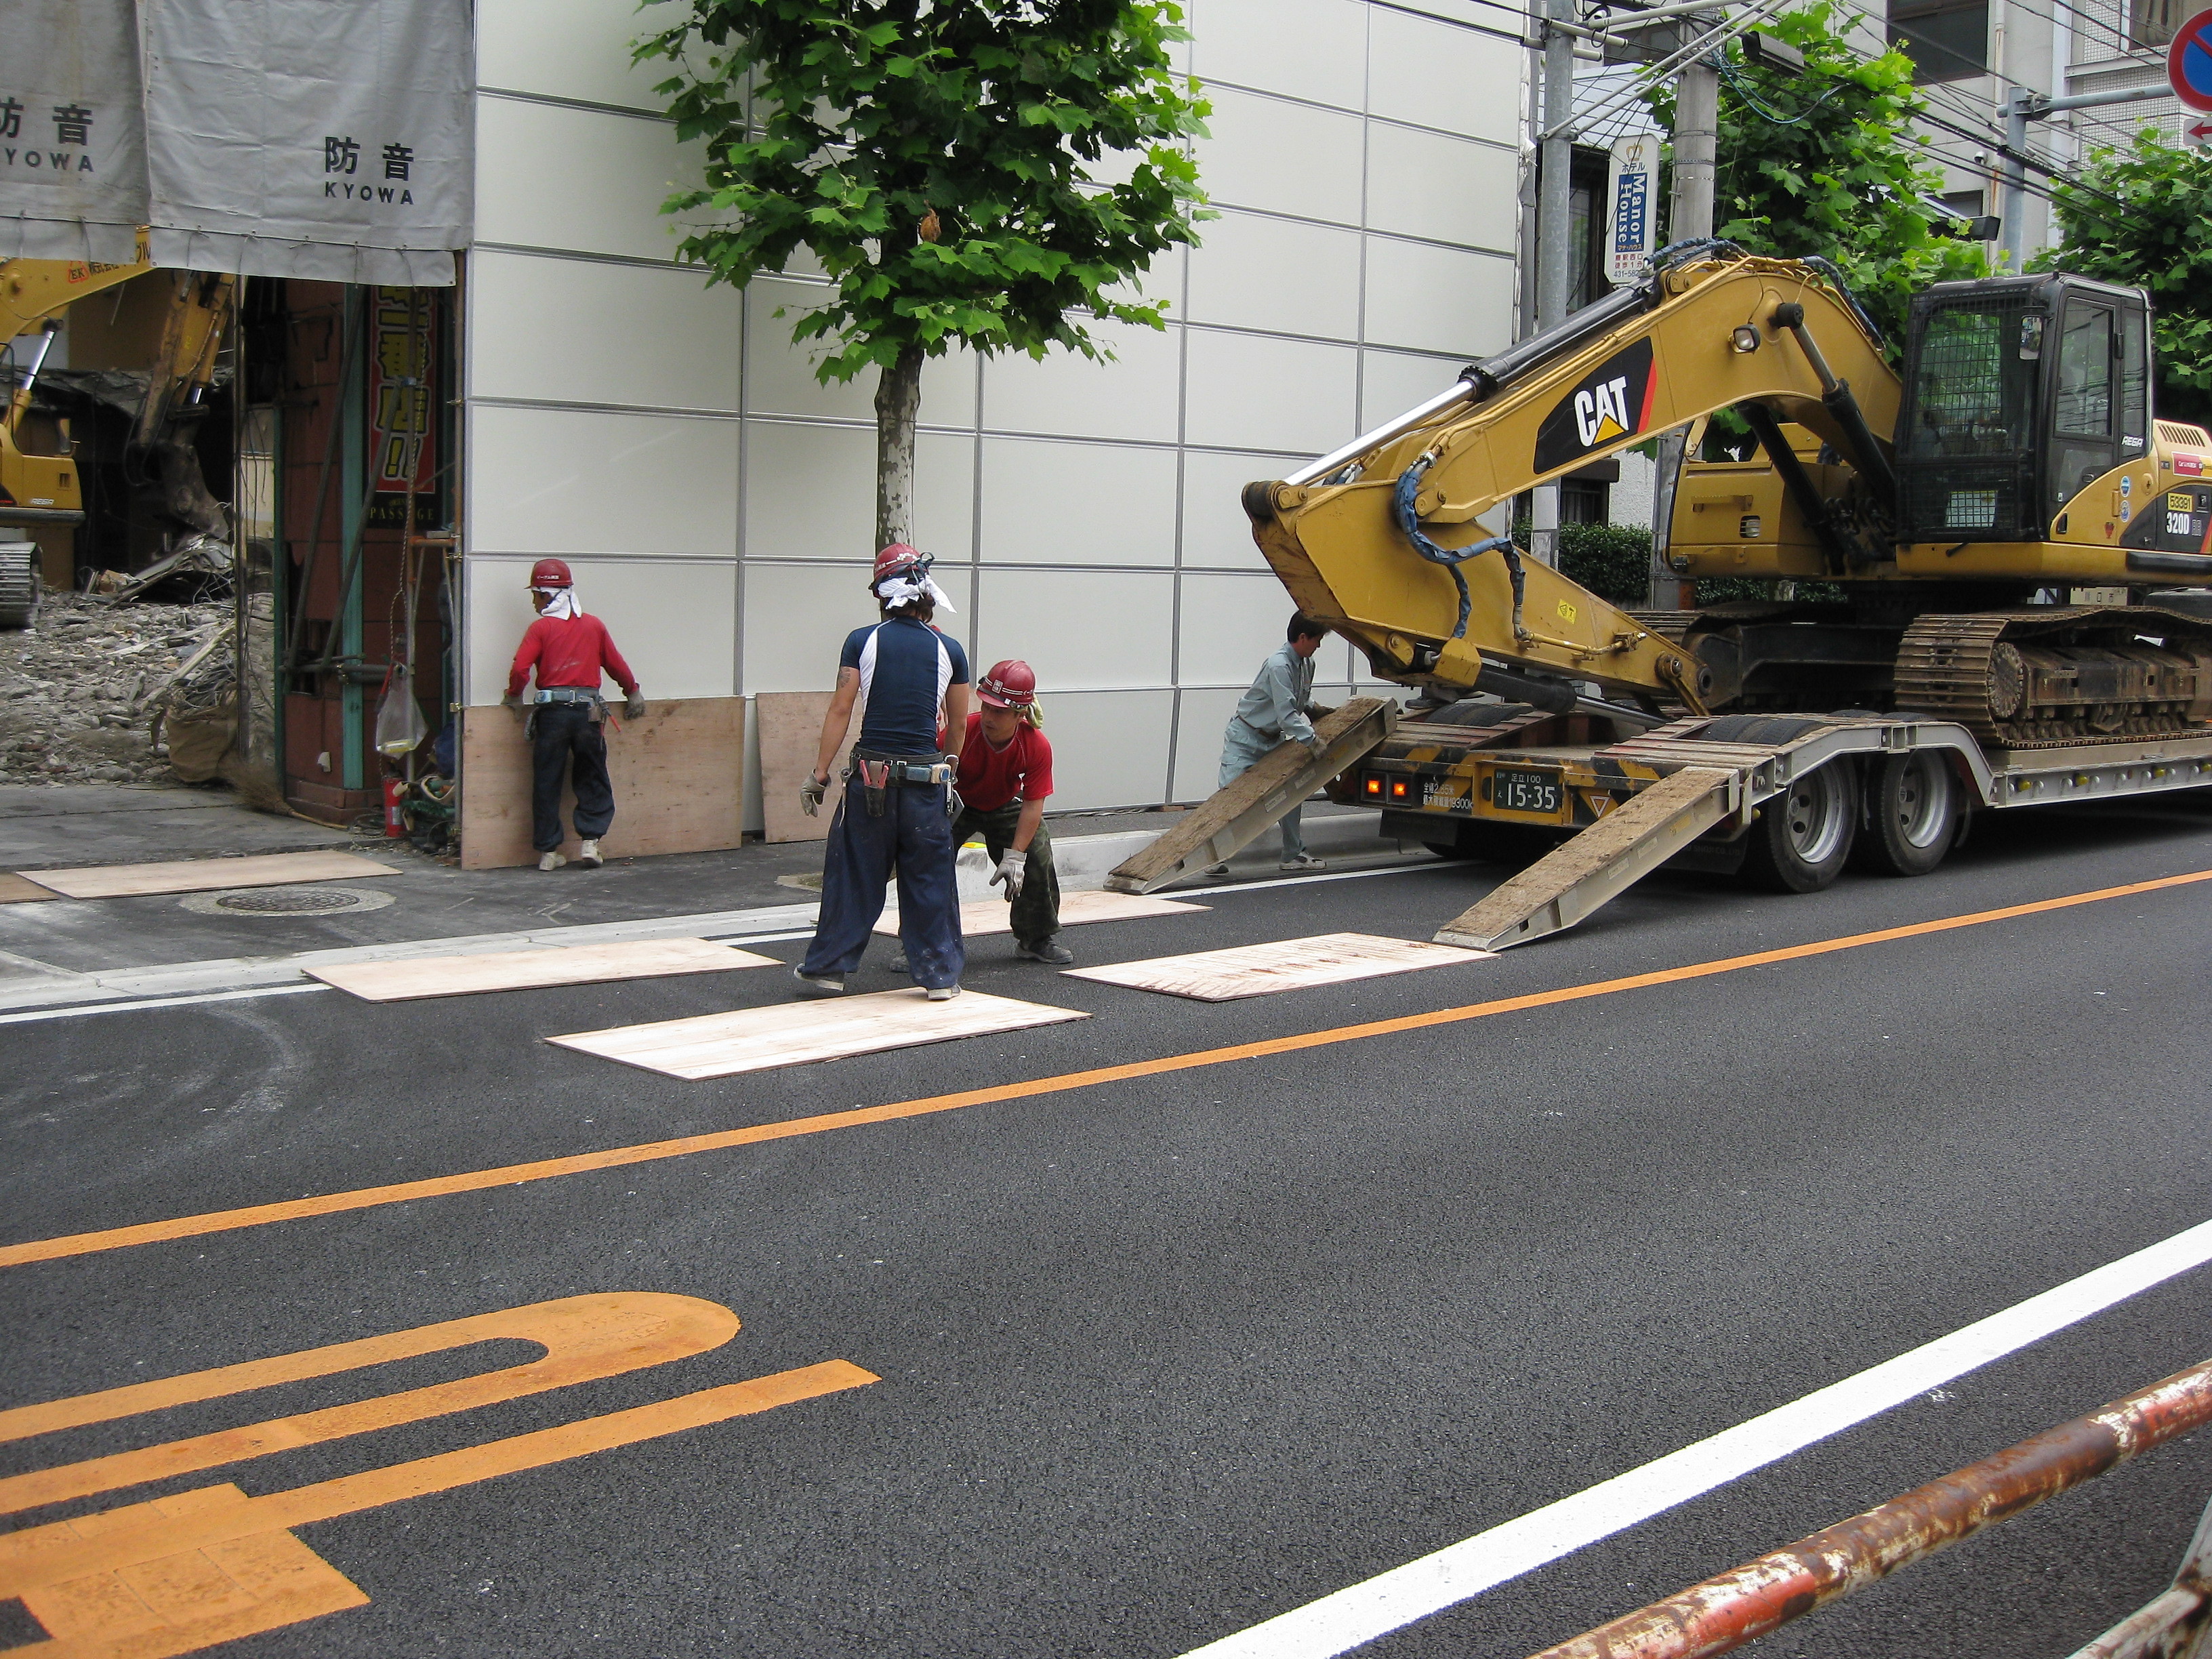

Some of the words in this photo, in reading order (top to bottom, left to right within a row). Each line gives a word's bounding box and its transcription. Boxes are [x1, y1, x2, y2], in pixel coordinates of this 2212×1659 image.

[325, 136, 414, 181] 防音
[1622, 162, 1645, 173] ホテル
[325, 181, 414, 205] KYOWA
[1618, 183, 1632, 243] House
[1631, 175, 1645, 243] Manor
[1574, 375, 1629, 447] CAT
[370, 507, 434, 519] PASSGE
[2170, 495, 2191, 510] 53391
[2167, 512, 2190, 535] 320D
[1508, 783, 1555, 809] 15-35
